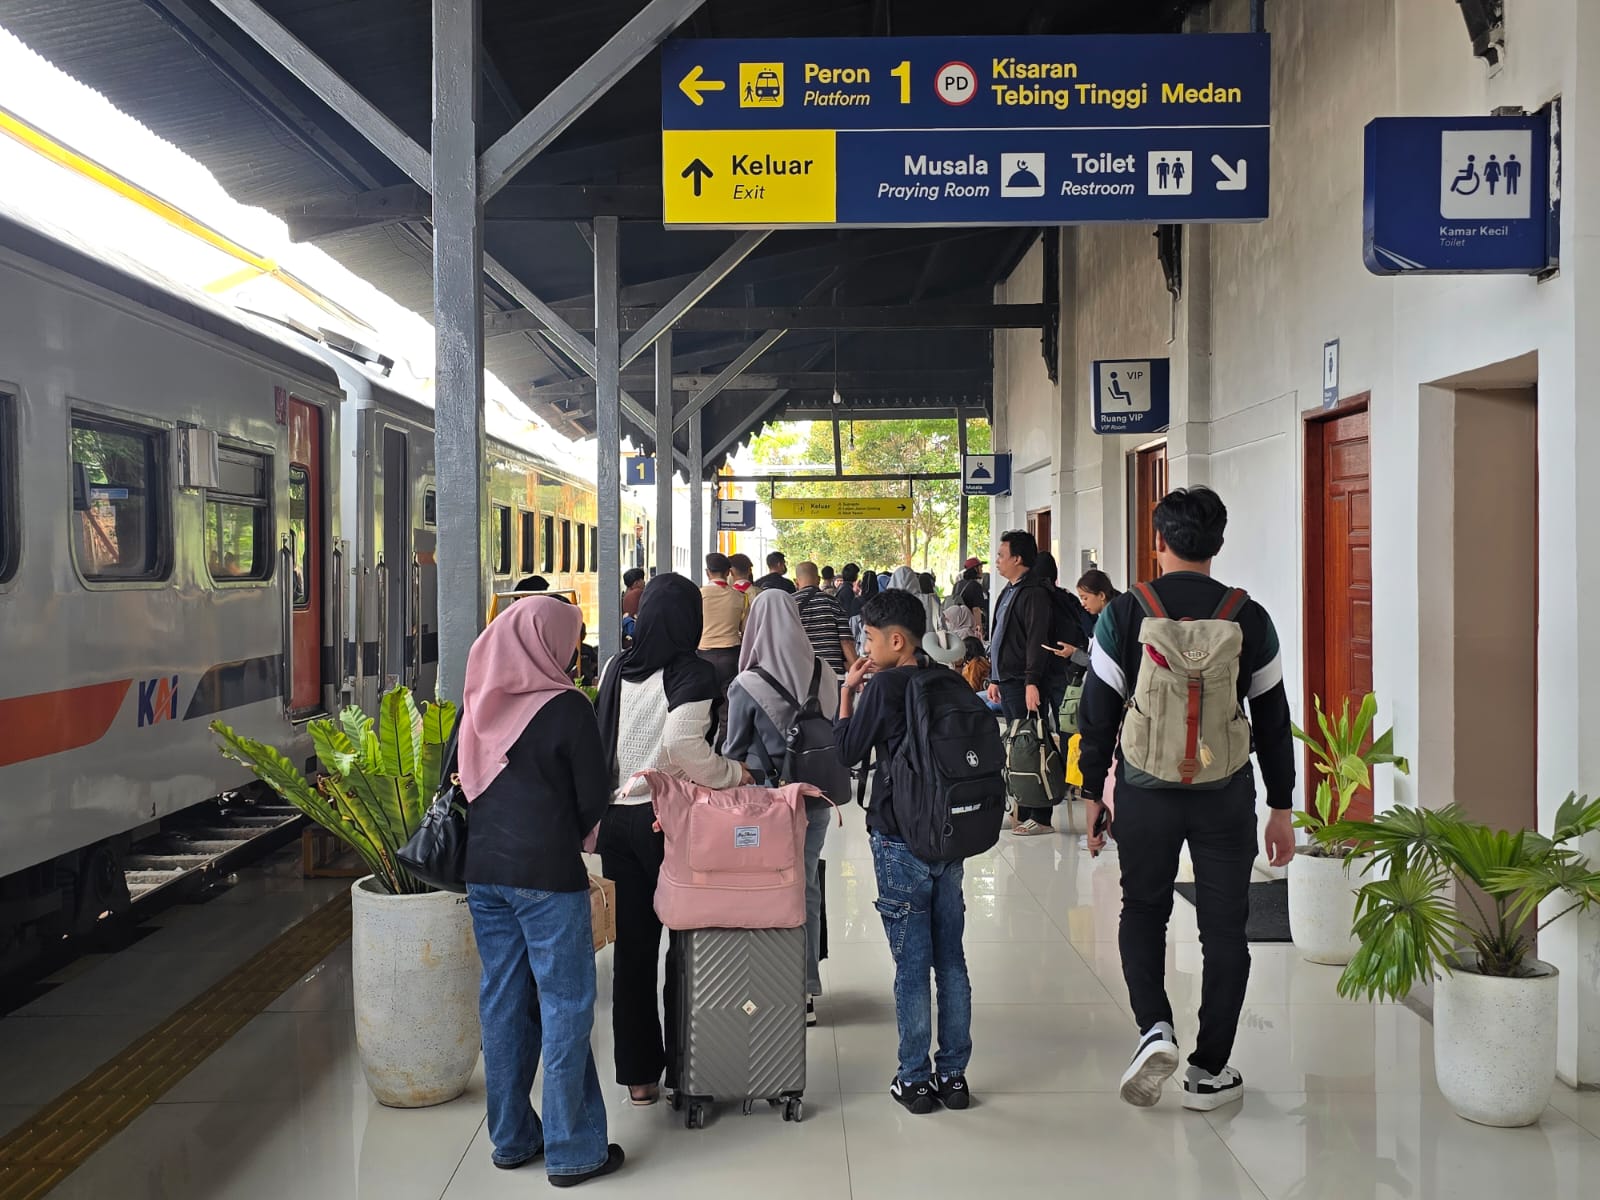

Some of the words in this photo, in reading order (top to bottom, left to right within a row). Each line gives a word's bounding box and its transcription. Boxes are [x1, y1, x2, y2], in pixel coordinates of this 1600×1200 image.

[992, 57, 1078, 79] Kisaran
[804, 63, 870, 84] Peron
[890, 60, 912, 104] 1
[944, 76, 969, 91] PD
[803, 90, 871, 106] Platform
[991, 83, 1069, 109] Tebing
[1074, 83, 1148, 110] Tinggi
[1161, 82, 1242, 104] Medan
[731, 154, 814, 176] Keluar
[904, 154, 989, 176] Musala
[1071, 152, 1136, 174] Toilet
[732, 184, 766, 200] Exit
[877, 182, 940, 200] Praying
[943, 181, 990, 198] Room
[1060, 180, 1135, 196] Restroom
[1439, 226, 1477, 236] Kamar
[1479, 225, 1509, 236] Kecil
[1439, 238, 1466, 247] Toilet
[1126, 371, 1143, 380] VIP
[1100, 414, 1127, 424] Ruang
[1128, 413, 1143, 422] VIP
[635, 462, 645, 480] 1
[137, 674, 178, 728] KAI
